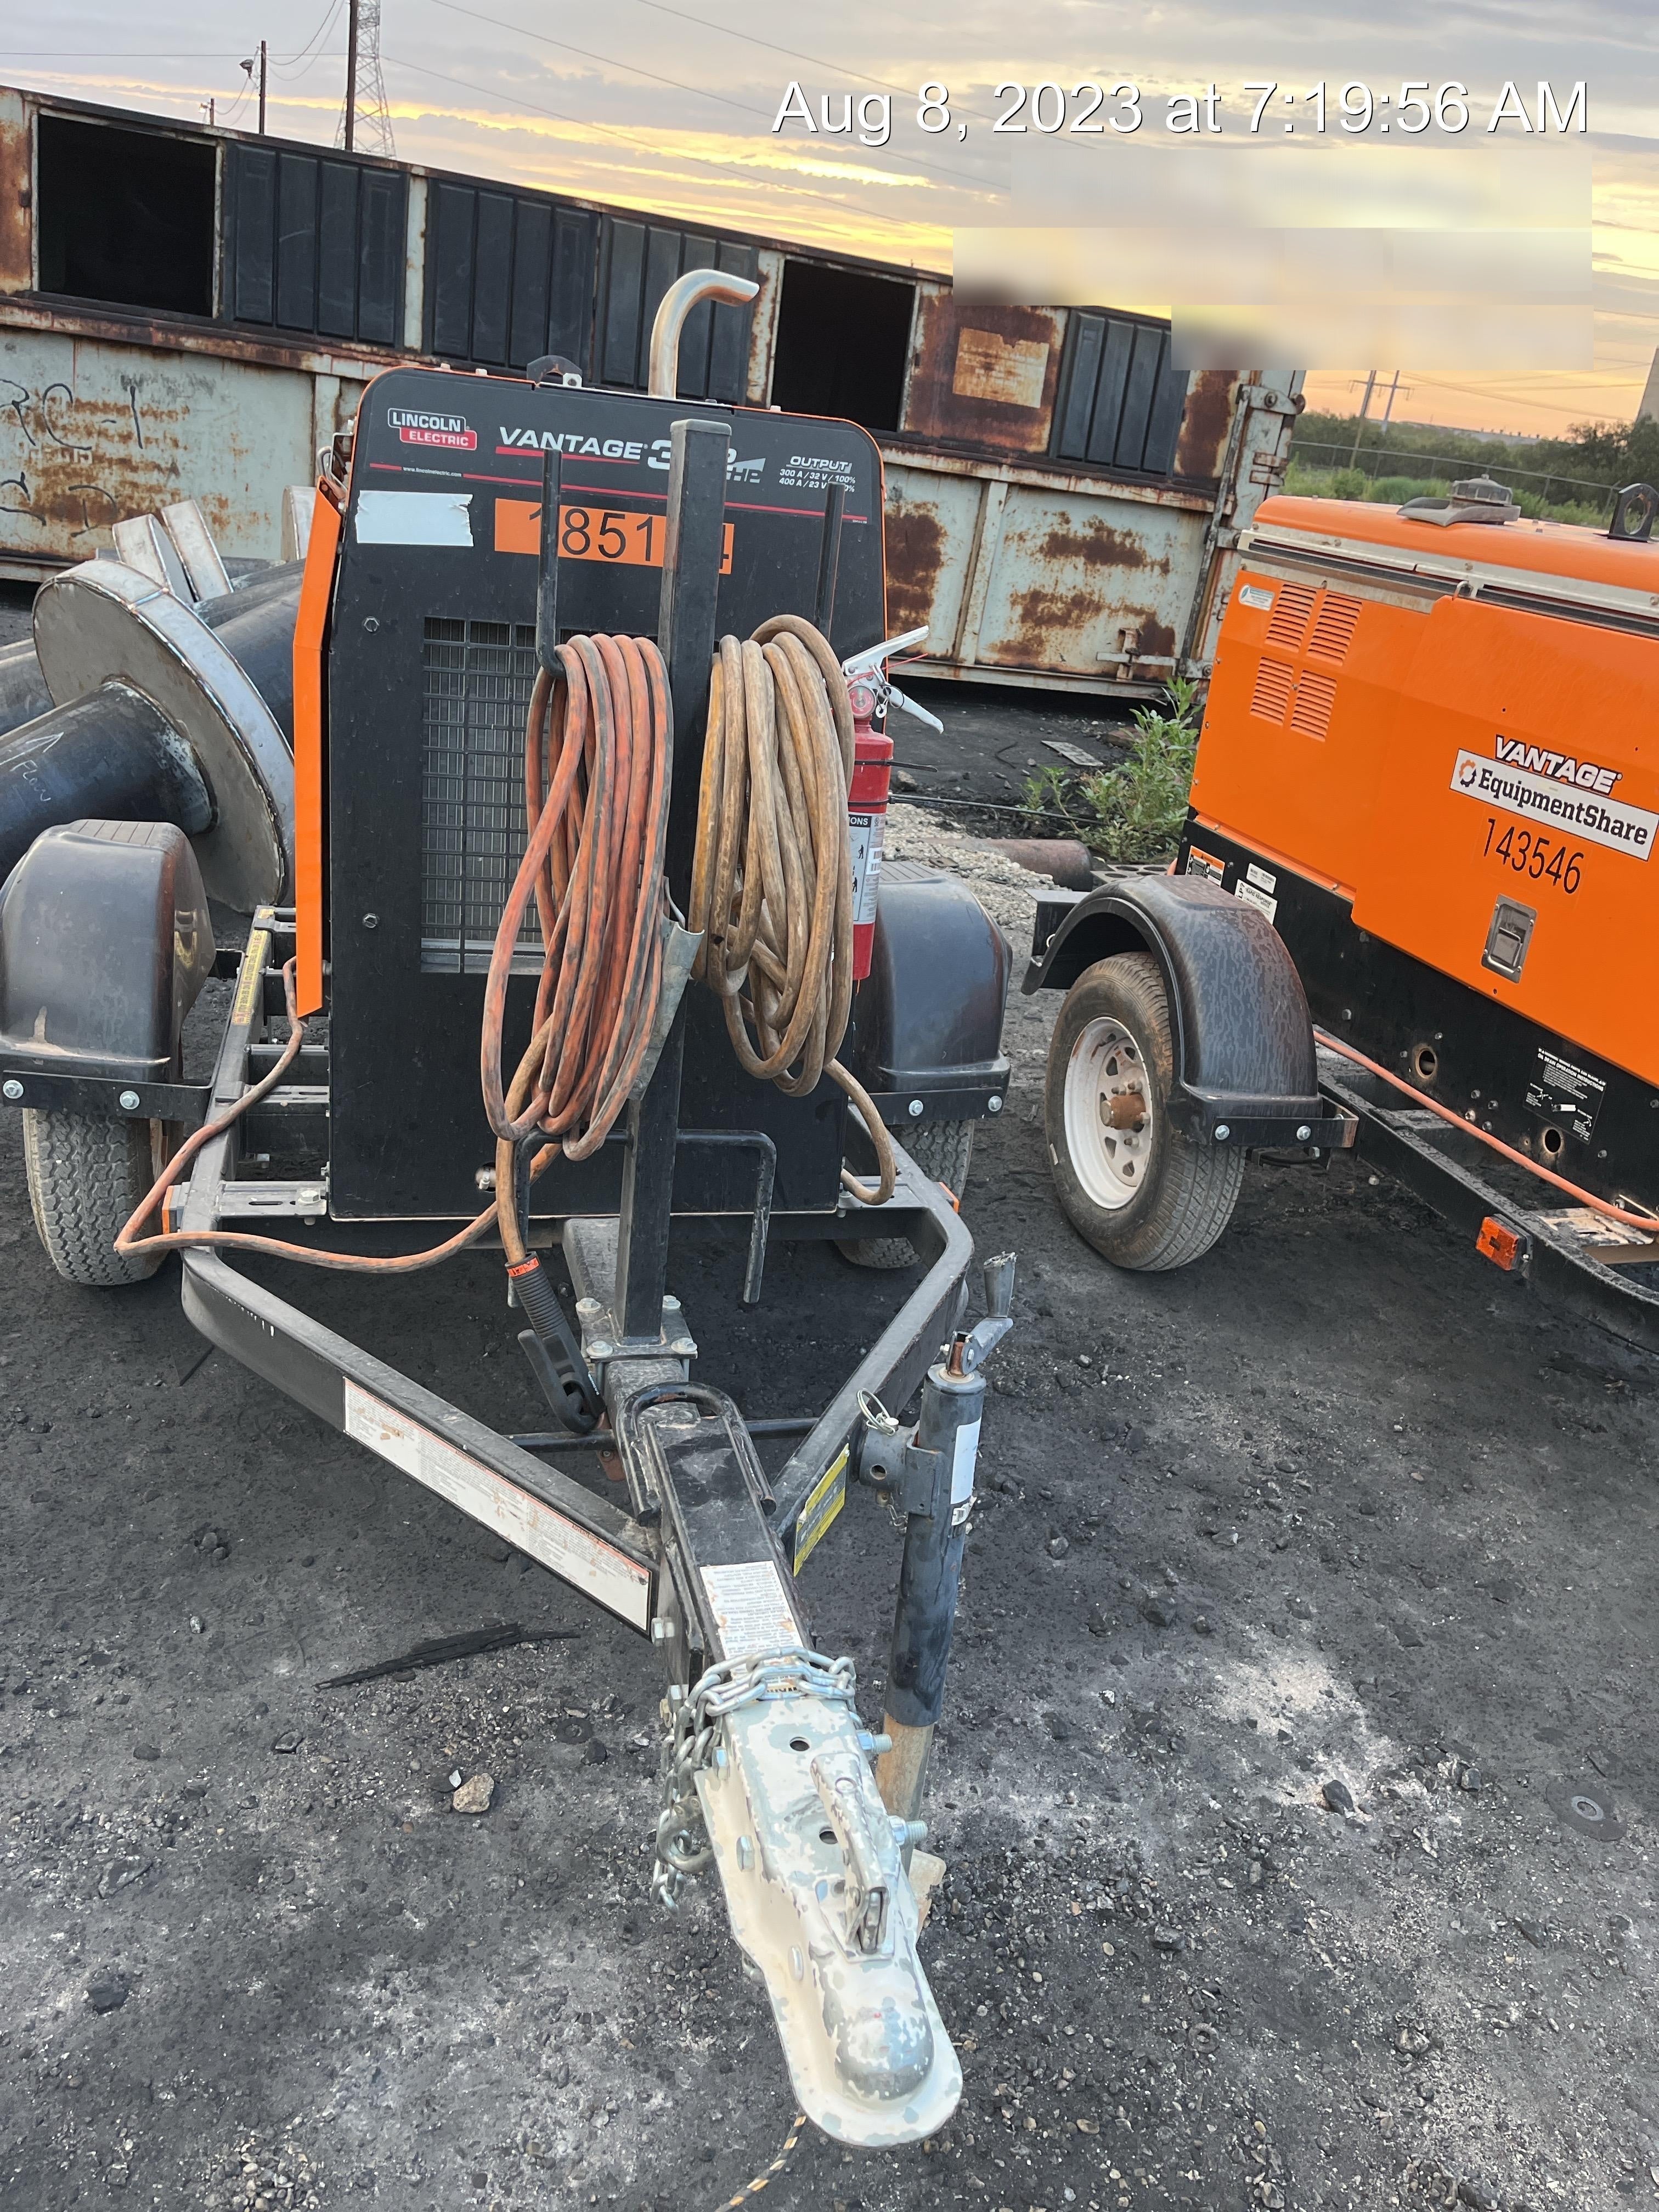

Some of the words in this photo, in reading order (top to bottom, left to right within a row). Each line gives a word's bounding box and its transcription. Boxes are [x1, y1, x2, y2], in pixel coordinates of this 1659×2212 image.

[392, 411, 461, 432] LINCOLN
[409, 430, 470, 447] ELECTRIC
[498, 426, 644, 460] VANTAGE
[790, 456, 849, 471] OUTPUT
[779, 477, 795, 486] 400
[780, 469, 795, 477] 300
[834, 475, 856, 484] 100%
[1496, 734, 1617, 795] VANTAGE
[1478, 768, 1649, 845] EquipmentShare
[1483, 818, 1585, 895] 143546
